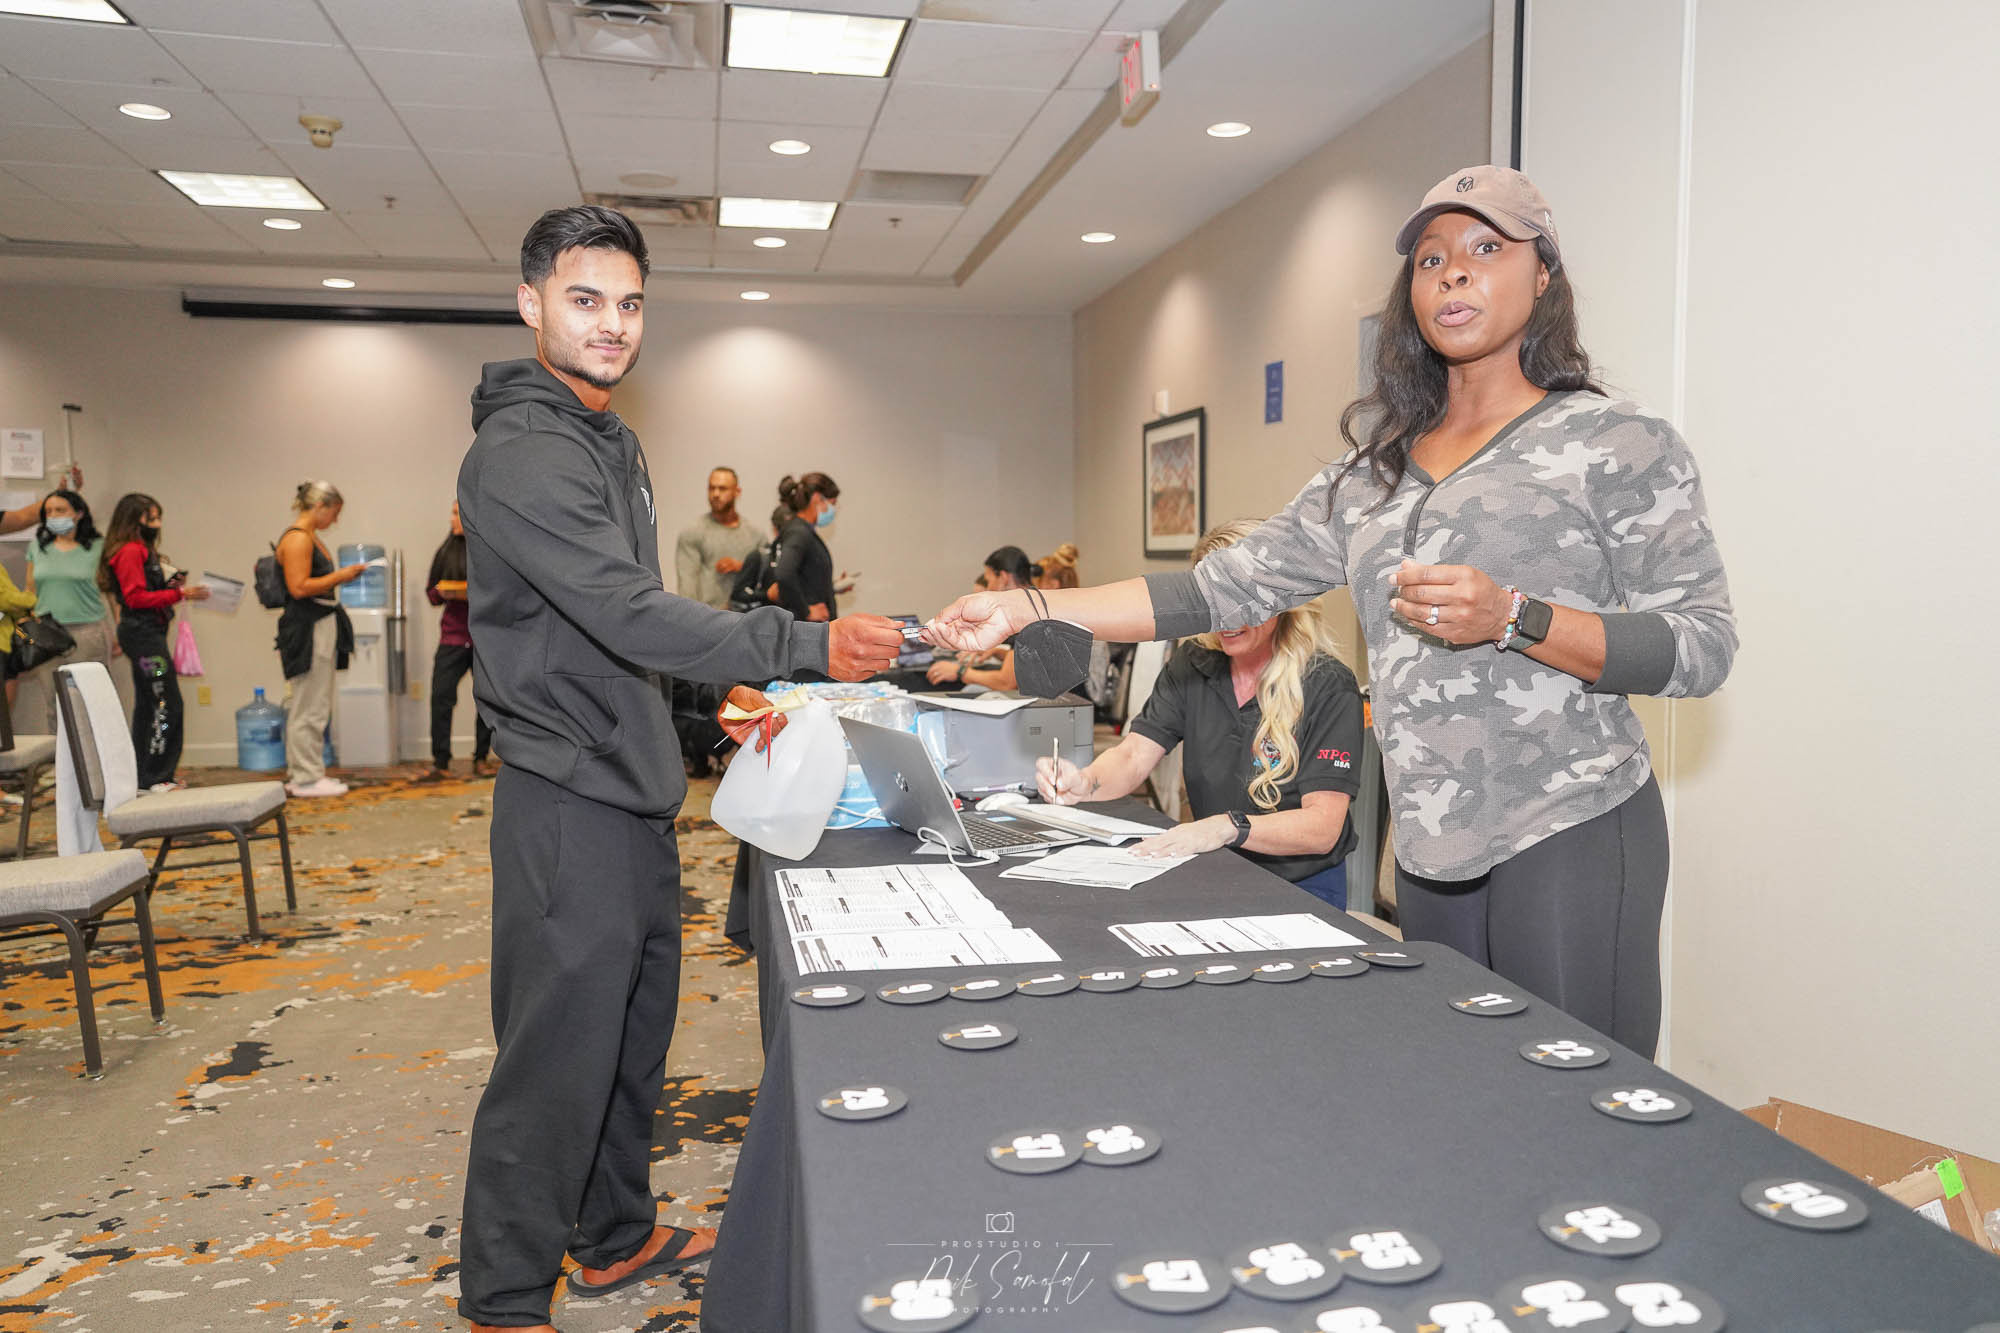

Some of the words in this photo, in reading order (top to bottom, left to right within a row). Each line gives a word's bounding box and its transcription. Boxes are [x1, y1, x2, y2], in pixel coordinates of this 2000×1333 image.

[1317, 749, 1351, 762] NPC
[1333, 760, 1350, 769] USA
[1261, 961, 1295, 973] 3
[1318, 957, 1353, 969] 2
[1091, 970, 1126, 982] 5
[1469, 992, 1514, 1008] 11
[1536, 1039, 1595, 1062] 22
[1611, 1088, 1676, 1114] 33
[1764, 1181, 1848, 1218] 50
[1564, 1205, 1642, 1244] 52
[1349, 1230, 1423, 1271] 55
[1315, 1305, 1394, 1333] 6
